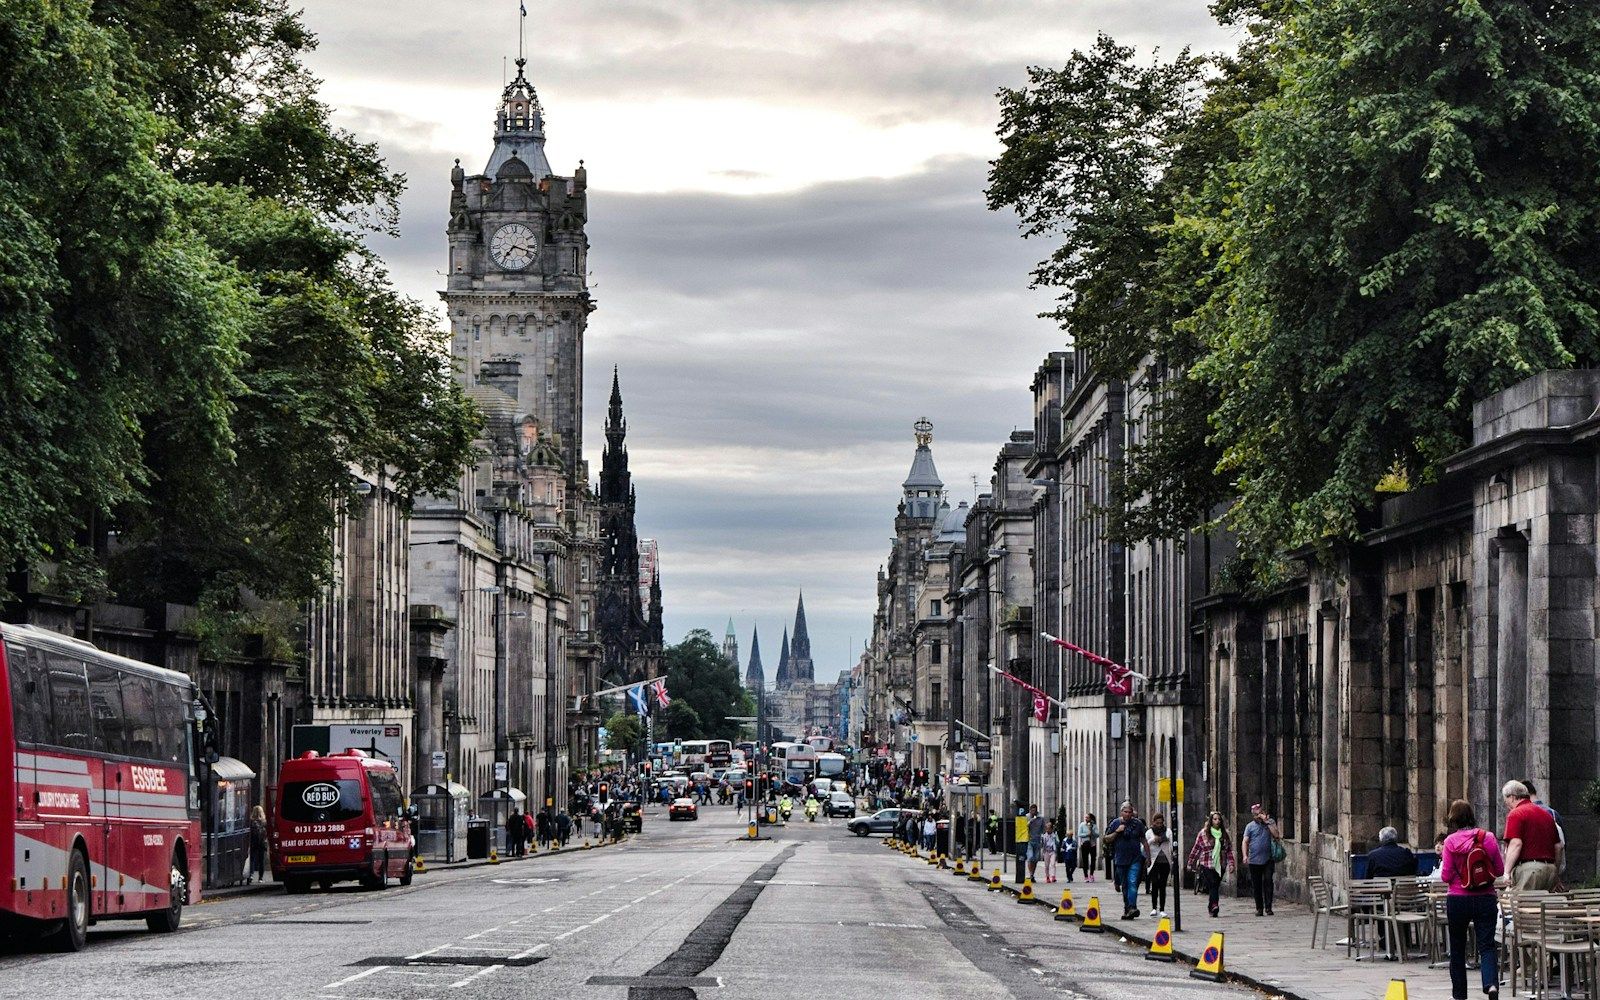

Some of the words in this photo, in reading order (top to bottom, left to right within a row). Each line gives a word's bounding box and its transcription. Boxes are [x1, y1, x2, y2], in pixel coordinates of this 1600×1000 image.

[131, 766, 168, 791] ESSBEE
[55, 792, 70, 808] COACH
[306, 791, 321, 801] RED
[321, 791, 336, 801] BUS
[294, 825, 311, 833] 0131
[313, 825, 327, 833] 228
[328, 824, 345, 832] 2888
[297, 839, 304, 847] OF
[305, 838, 329, 846] SCOTLAND
[330, 837, 346, 845] TOURS
